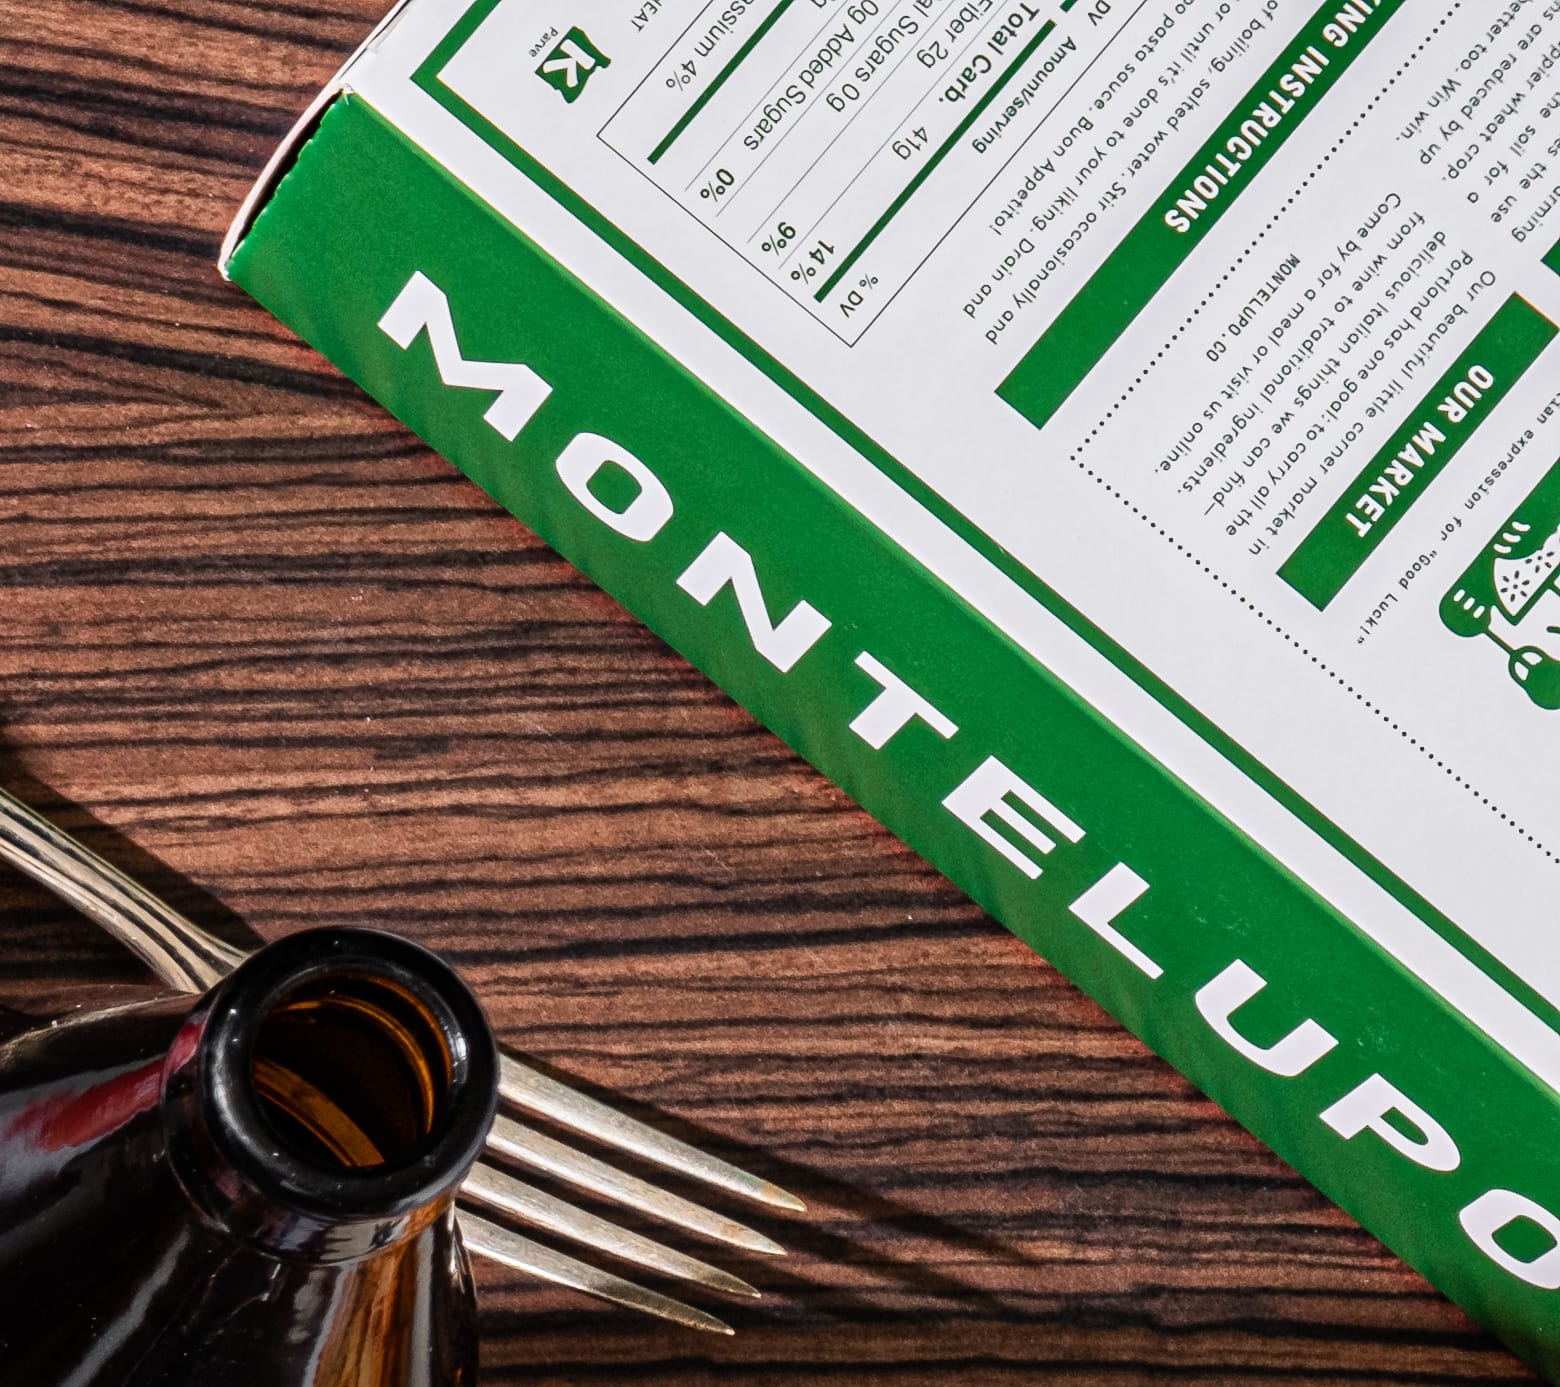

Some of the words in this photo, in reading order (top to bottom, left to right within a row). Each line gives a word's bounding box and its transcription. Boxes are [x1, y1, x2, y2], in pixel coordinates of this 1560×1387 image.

[528, 27, 559, 58] Parve
[986, 1, 1040, 56] Total
[1133, 12, 1175, 62] pasta
[1179, 21, 1215, 63] until
[1321, 0, 1374, 48] ING
[1516, 23, 1542, 51] are
[797, 22, 855, 90] Added
[853, 14, 919, 83] Sugars
[915, 39, 949, 70] 2g
[1207, 17, 1266, 74] boiling,
[1454, 43, 1487, 72] too.
[937, 53, 992, 103] Carb.
[1088, 62, 1136, 111] sauce.
[1156, 60, 1182, 87] it's
[1426, 77, 1462, 108] Win
[1459, 52, 1517, 121] reduced
[970, 35, 1077, 155] Amount/serving
[1121, 87, 1159, 128] done
[1165, 77, 1210, 132] salted
[742, 83, 807, 151] Sugars
[1051, 115, 1094, 158] Buon
[1394, 110, 1430, 141] win.
[1438, 119, 1464, 141] by
[1478, 91, 1526, 143] wheat
[890, 125, 928, 161] 41g
[1104, 129, 1125, 148] to
[1120, 129, 1169, 177] water.
[1163, 45, 1330, 233] INSTRUCTIONS
[1418, 142, 1441, 165] up
[1508, 124, 1536, 158] soil
[1073, 145, 1107, 186] your
[1441, 143, 1480, 180] crop.
[1482, 159, 1509, 186] for
[1518, 161, 1547, 190] the
[698, 167, 735, 203] 0%
[988, 157, 1056, 236] Appetito!
[1097, 180, 1127, 212] Stir
[1029, 185, 1079, 233] liking.
[1355, 192, 1402, 239] Come
[1489, 194, 1517, 223] use
[760, 220, 796, 256] 9%
[1335, 239, 1362, 262] by
[1385, 210, 1426, 251] from
[990, 237, 1036, 282] Drain
[1011, 211, 1097, 310] occasionally
[1316, 262, 1342, 288] for
[1350, 254, 1388, 292] wine
[1383, 230, 1446, 300] delicious
[838, 289, 864, 319] DV
[961, 283, 992, 319] and
[1333, 294, 1353, 314] to
[1408, 249, 1474, 321] Portland
[1465, 269, 1496, 302] Our
[983, 309, 1014, 346] and
[1204, 252, 1301, 363] MONTELUPO.CO
[1267, 301, 1305, 347] meal
[1337, 301, 1389, 355] Italian
[1382, 317, 1415, 349] has
[1399, 302, 1468, 380] beautiful
[1251, 344, 1268, 365] or
[1258, 316, 1335, 404] traditional
[1356, 349, 1385, 380] one
[1219, 365, 1253, 400] visit
[1292, 357, 1341, 408] things
[1320, 377, 1358, 423] goal:
[1364, 378, 1404, 418] little
[1436, 364, 1494, 423] OUR
[1201, 400, 1223, 421] us
[1270, 411, 1295, 435] we
[1153, 421, 1203, 473] online.
[1176, 402, 1260, 494] ingredients.
[1241, 437, 1271, 468] can
[1304, 422, 1325, 442] to
[1318, 421, 1364, 475] corner
[1266, 441, 1307, 486] carry
[1344, 420, 1446, 538] MARKET
[1463, 412, 1548, 510] expression
[1249, 485, 1270, 511] all
[1264, 475, 1318, 536] market
[1224, 508, 1253, 536] the
[1439, 515, 1462, 542] for
[1247, 537, 1270, 556] in
[1397, 549, 1437, 590] "Good
[1356, 592, 1398, 645] Luck!"
[377, 270, 1560, 1290] MONTELUPO
